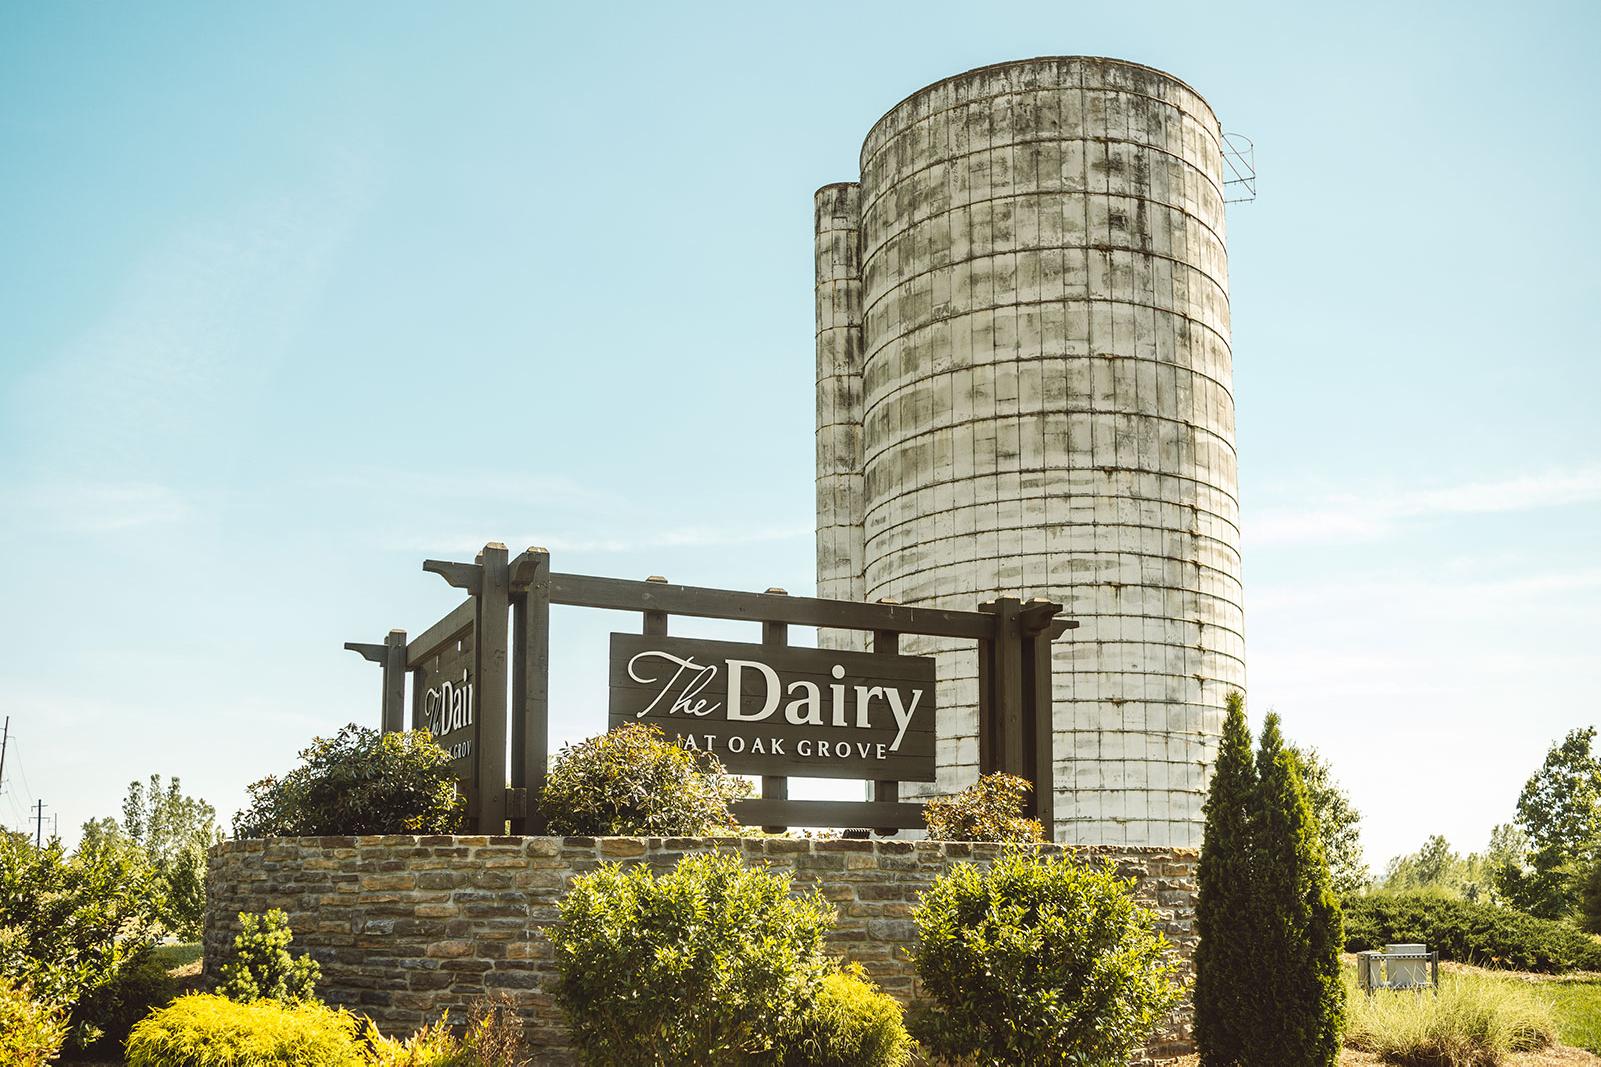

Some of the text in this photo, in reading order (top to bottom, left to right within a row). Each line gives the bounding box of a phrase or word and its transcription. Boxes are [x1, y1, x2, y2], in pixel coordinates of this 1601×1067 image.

[442, 668, 473, 736] Dair
[628, 651, 923, 751] The Dairy
[453, 739, 472, 760] GROV
[684, 734, 888, 760] AT OAK GROVE
